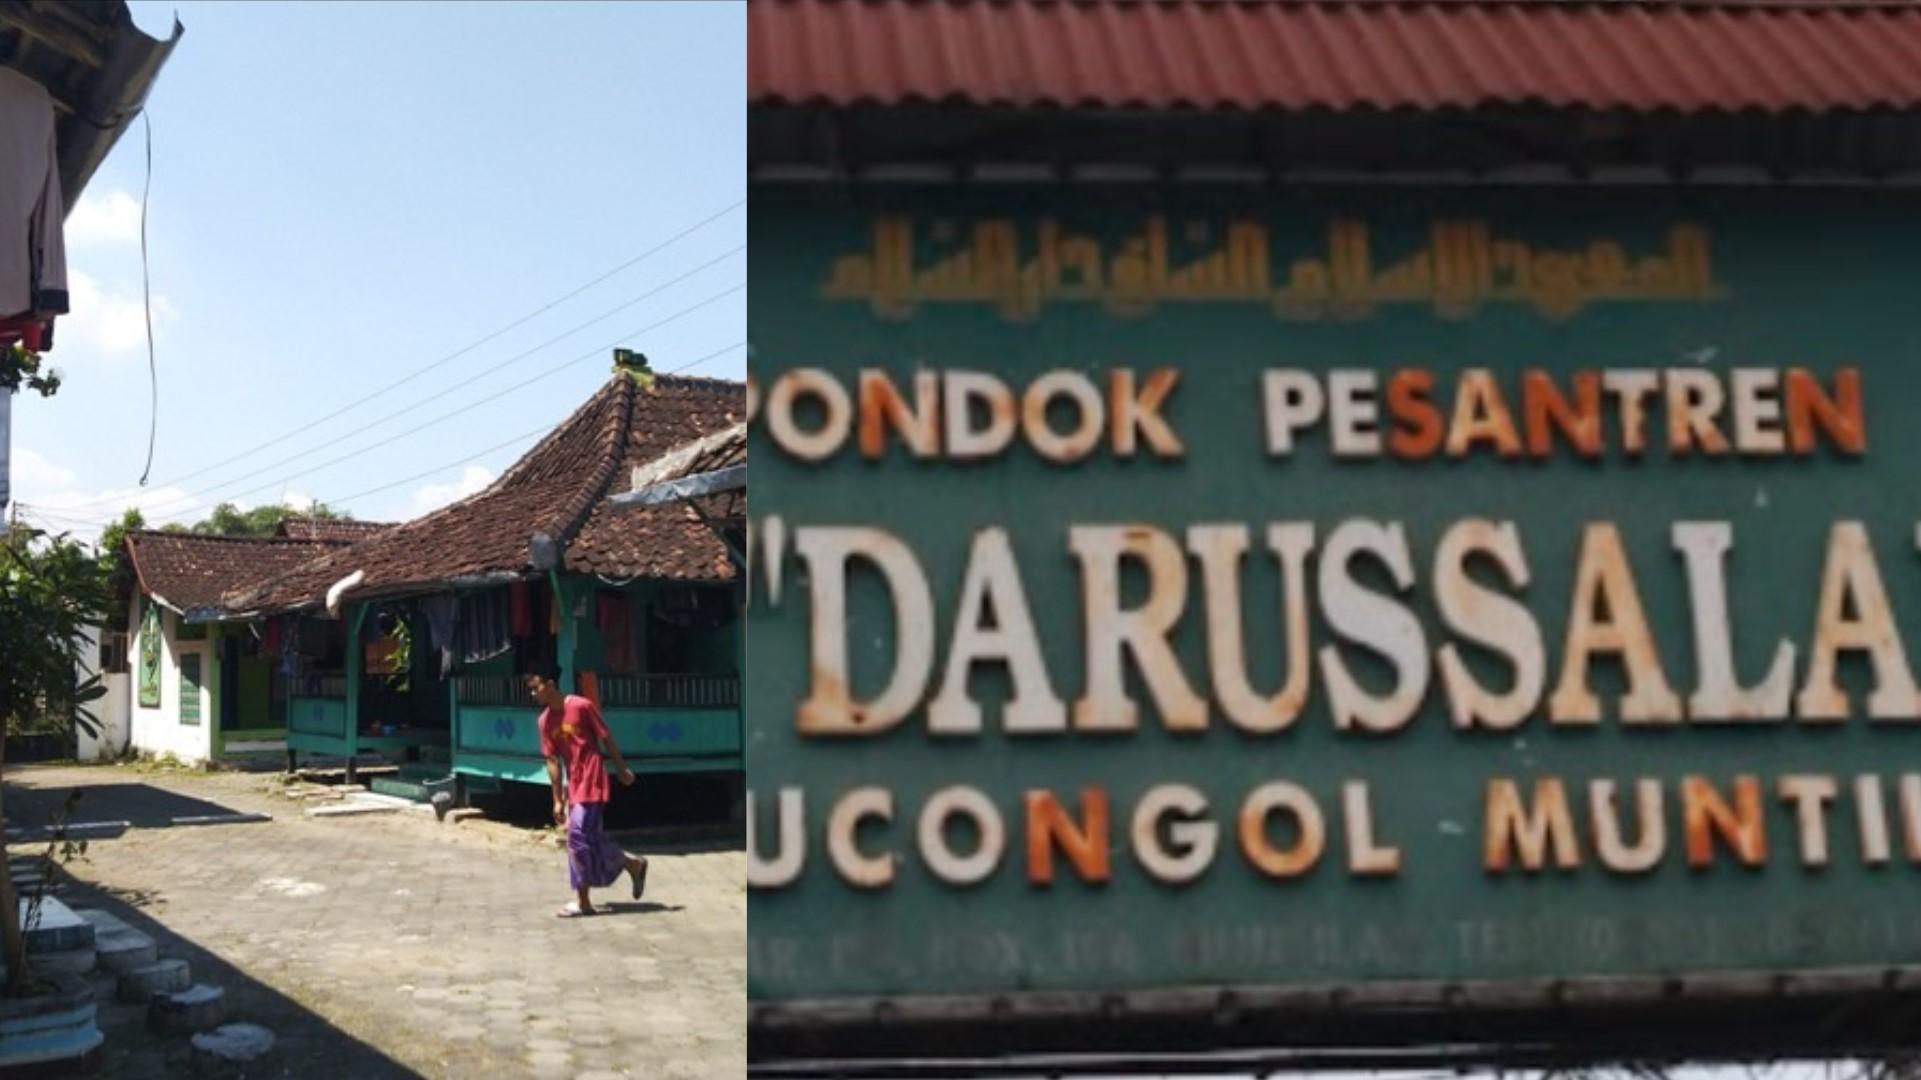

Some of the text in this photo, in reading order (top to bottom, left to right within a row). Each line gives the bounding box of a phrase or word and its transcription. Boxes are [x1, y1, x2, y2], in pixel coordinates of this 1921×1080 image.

[747, 366, 1866, 461] ONDOK PESANTREN
[747, 514, 1921, 735] "DARUSSALA
